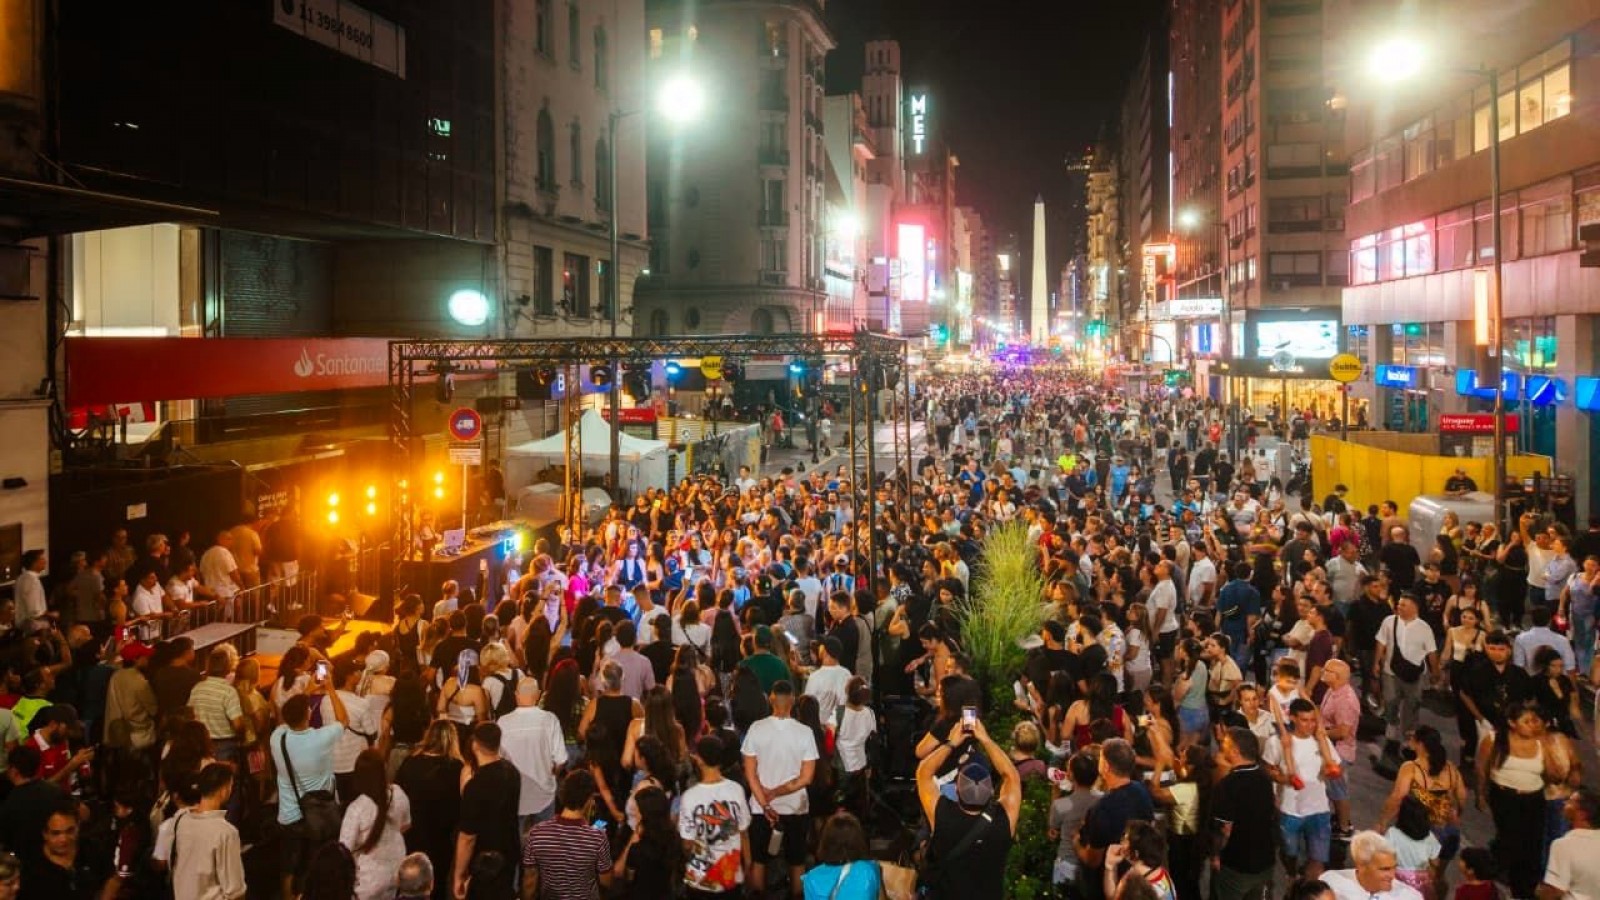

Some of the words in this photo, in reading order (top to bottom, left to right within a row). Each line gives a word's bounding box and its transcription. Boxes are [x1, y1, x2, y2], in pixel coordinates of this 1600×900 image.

[301, 3, 313, 24] 11
[911, 94, 926, 154] MET
[316, 354, 388, 376] Santander
[1442, 416, 1474, 426] Uruguay
